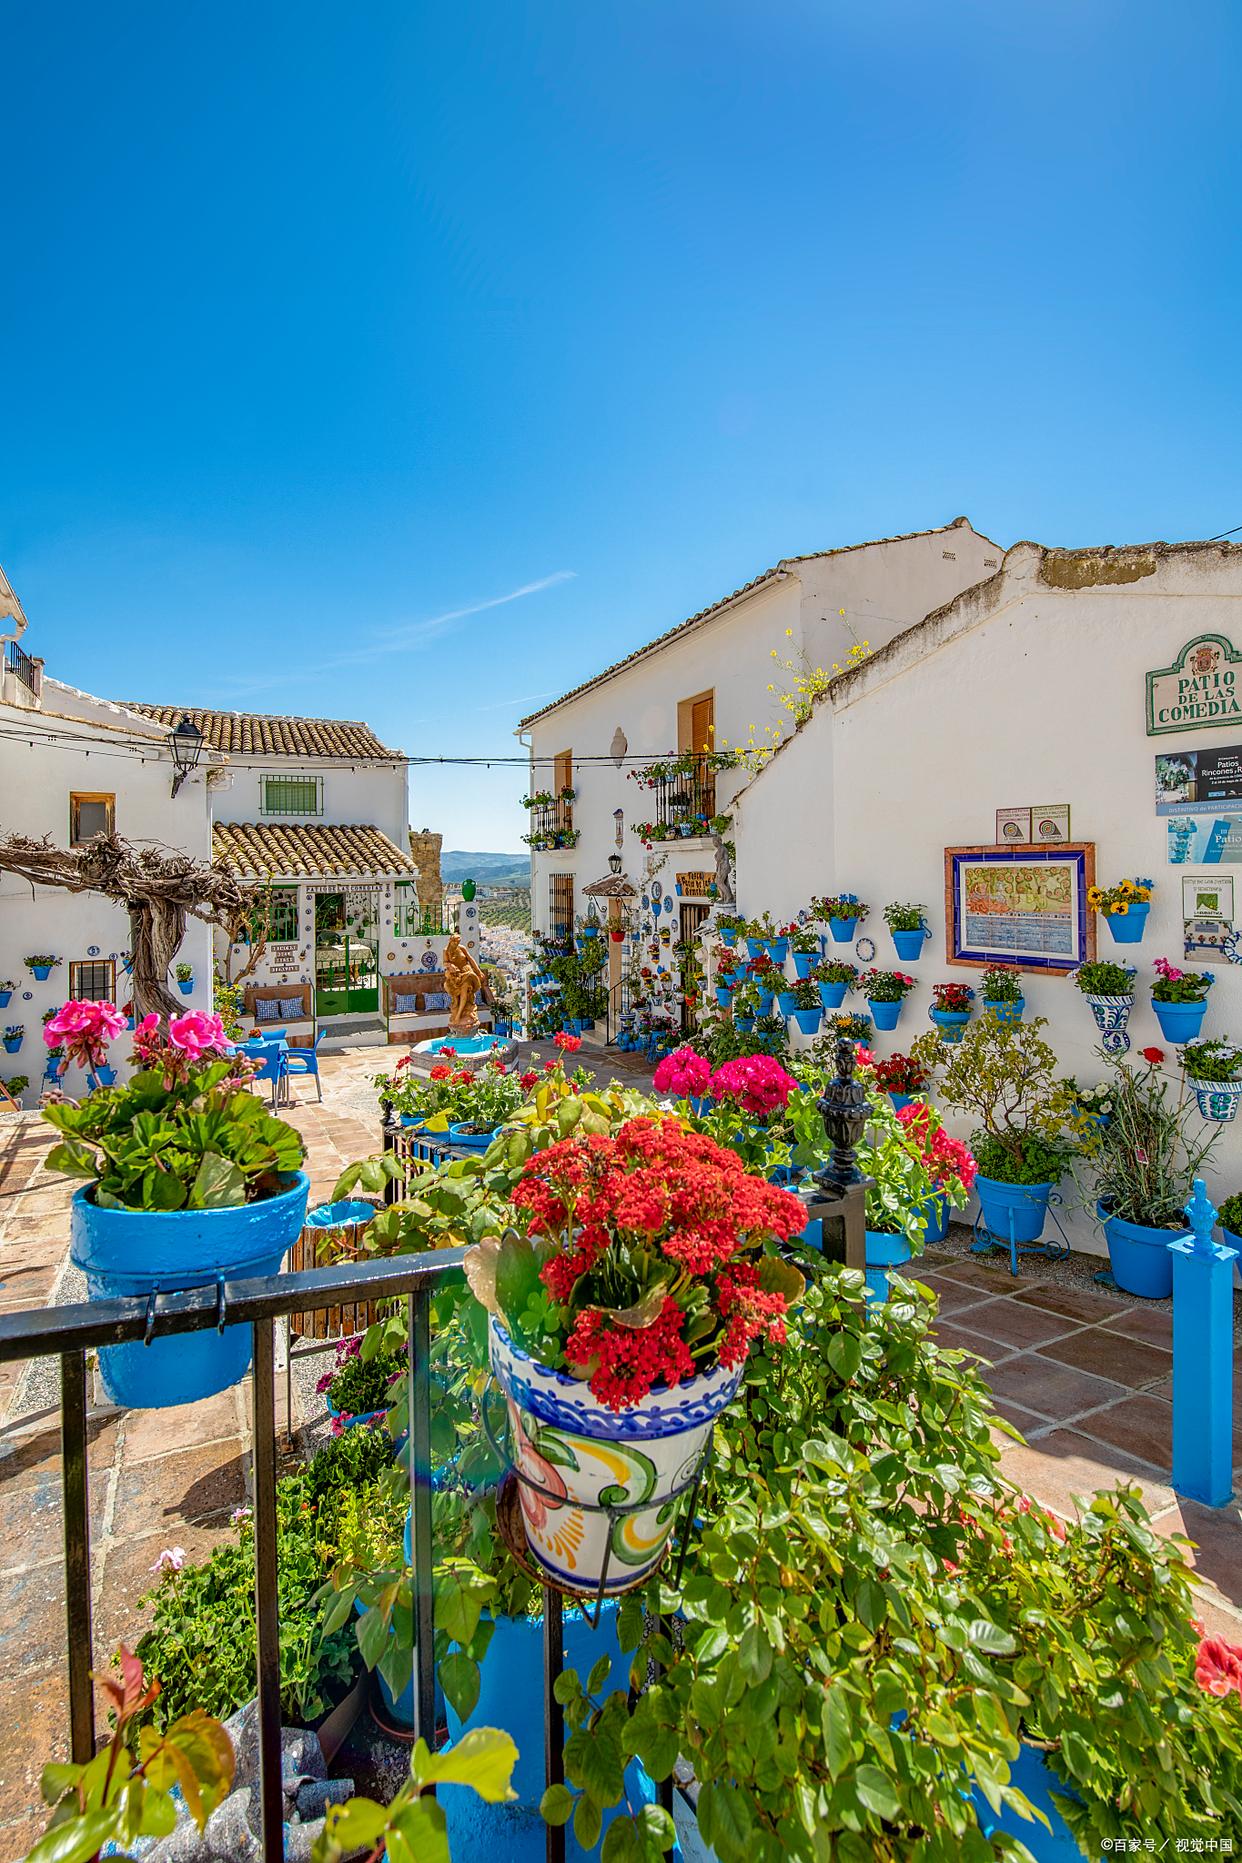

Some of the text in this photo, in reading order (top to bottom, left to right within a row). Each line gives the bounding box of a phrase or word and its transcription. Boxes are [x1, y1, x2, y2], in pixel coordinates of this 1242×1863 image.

[1177, 671, 1235, 694] PATIO
[1178, 687, 1235, 705] DE LAS
[1158, 697, 1242, 723] COMEDIA
[1201, 768, 1234, 777] Rincones
[1217, 760, 1239, 769] Patios
